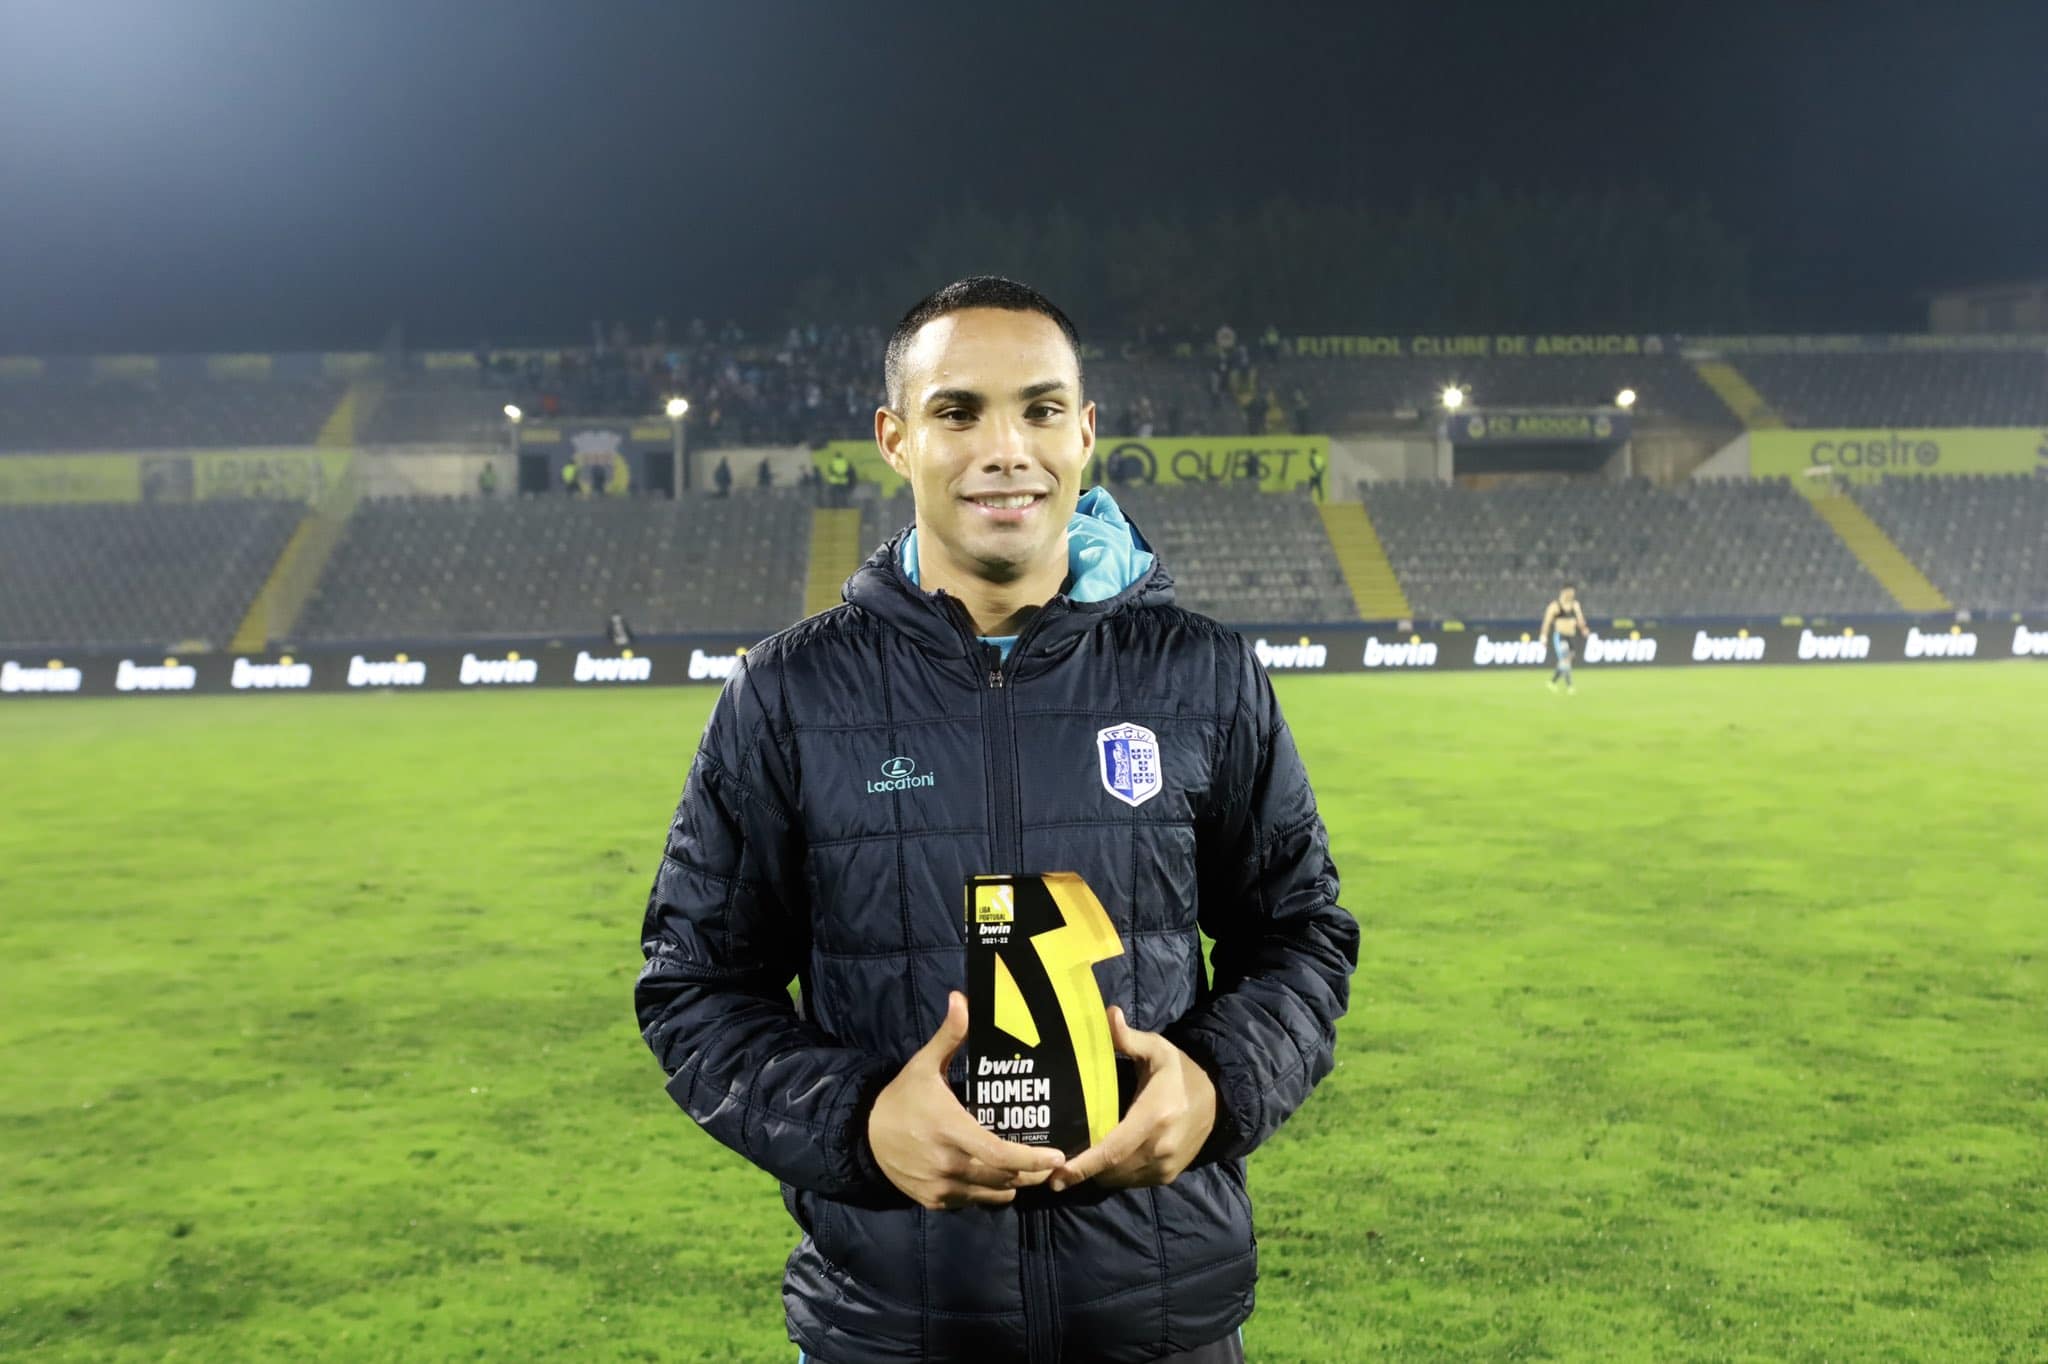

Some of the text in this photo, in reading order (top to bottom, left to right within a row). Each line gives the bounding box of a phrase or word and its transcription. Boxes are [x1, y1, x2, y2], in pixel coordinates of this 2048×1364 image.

[1297, 335, 1639, 355] FUTEBOL CLUBE DE AROUCA
[1810, 433, 1940, 468] castro
[1171, 448, 1299, 482] QUEST
[1254, 625, 2048, 668] bwin bwin bwin bwin bwin bwin bwin bw
[0, 647, 746, 692] bwin bwin bwin bwin bwin bwin bw
[867, 771, 935, 793] Lacatoni
[979, 922, 1011, 936] bwin
[981, 937, 1009, 945] 2021-22
[977, 1053, 1035, 1077] bwin
[977, 1078, 1051, 1105] HOMEM
[977, 1104, 1051, 1130] DO JOGO
